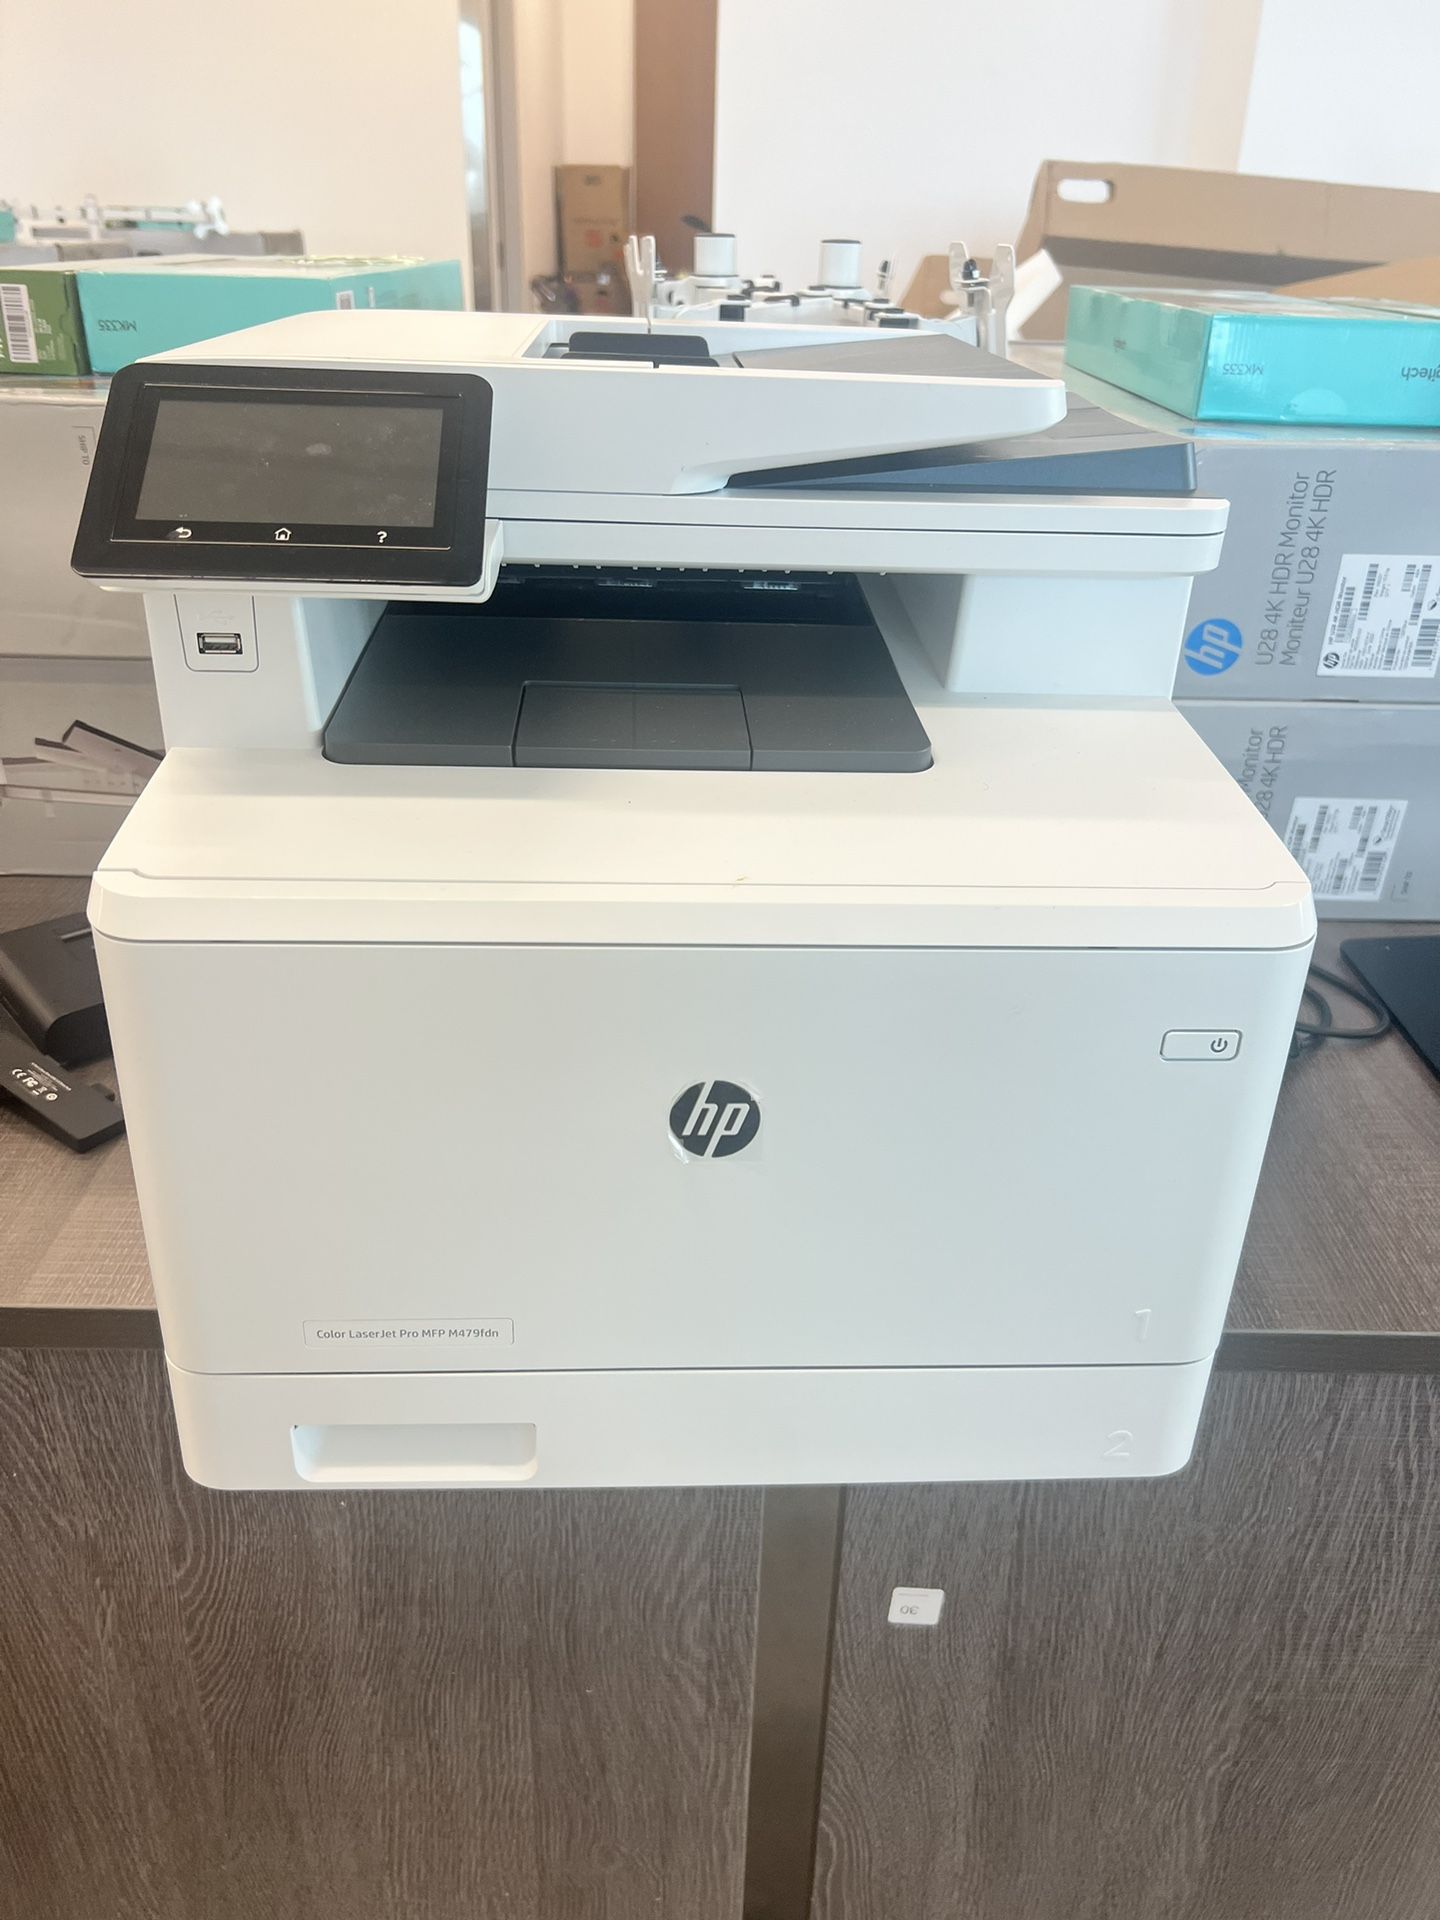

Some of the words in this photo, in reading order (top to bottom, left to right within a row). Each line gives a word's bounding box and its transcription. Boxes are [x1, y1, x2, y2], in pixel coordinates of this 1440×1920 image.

[1222, 363, 1264, 376] MK335
[81, 454, 90, 466] TO
[1310, 469, 1337, 513] HDR
[1278, 472, 1310, 548] Monitor
[1305, 516, 1328, 542] 4K
[1269, 552, 1295, 595] HDR
[1296, 545, 1320, 585] U28
[1264, 599, 1286, 625] 4K
[1279, 588, 1312, 666] Moniteur
[1184, 618, 1244, 677] hp
[1255, 628, 1279, 666] U28
[1322, 651, 1340, 669] hp
[1264, 725, 1288, 763] HDR
[1261, 766, 1280, 788] 4K
[1255, 790, 1274, 820] 28
[669, 1080, 761, 1158] hp
[316, 1329, 346, 1339] Color
[349, 1328, 397, 1339] LaserJet
[400, 1329, 419, 1339] Pro
[421, 1328, 445, 1338] MFP
[449, 1328, 499, 1338] M479fdn
[1135, 1308, 1152, 1340] 1
[1103, 1429, 1133, 1457] 2
